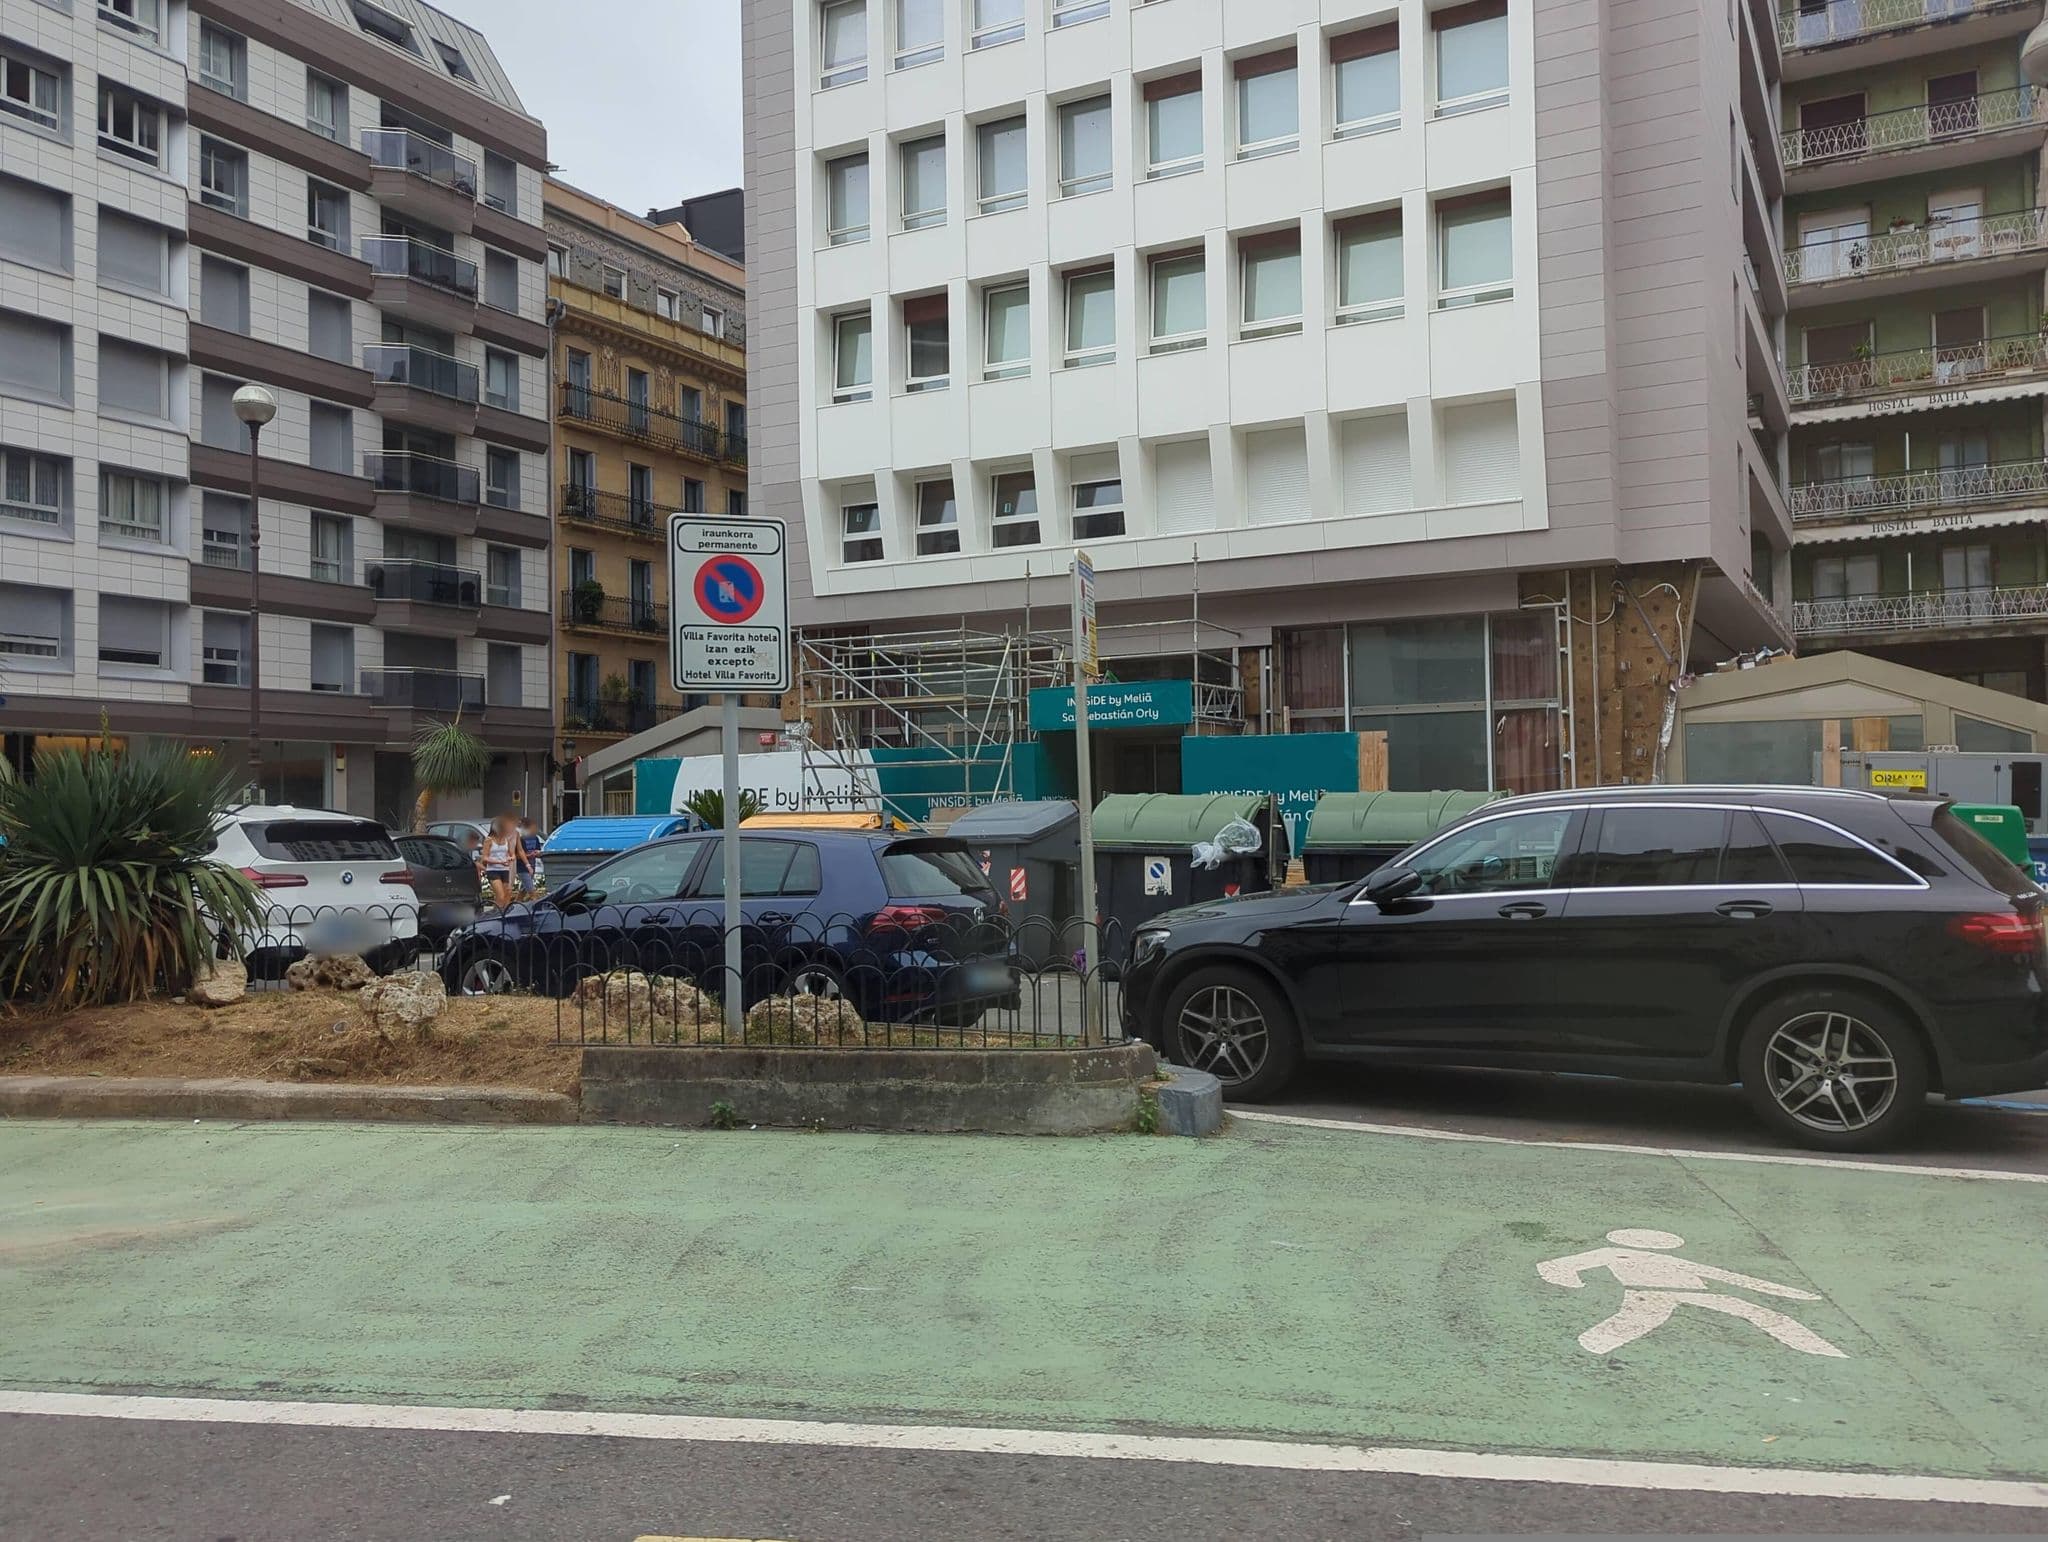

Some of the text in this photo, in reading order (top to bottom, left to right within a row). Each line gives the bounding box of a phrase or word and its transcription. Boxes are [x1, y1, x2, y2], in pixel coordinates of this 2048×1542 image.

[1868, 391, 1969, 412] HOSTAL BAHIA
[1872, 514, 1973, 533] HOSTAL BAHIA
[702, 528, 753, 539] iraunkorra
[698, 540, 758, 550] permanente
[683, 631, 777, 642] Villa Favorita hotela
[705, 644, 756, 654] izan ezik
[707, 658, 755, 667] excepto
[685, 670, 776, 680] Hotel Villa Favorita
[1067, 695, 1107, 707] INSiDE
[1109, 695, 1122, 707] by
[1062, 708, 1159, 722] Sa ebastián Orly
[775, 785, 800, 811] by
